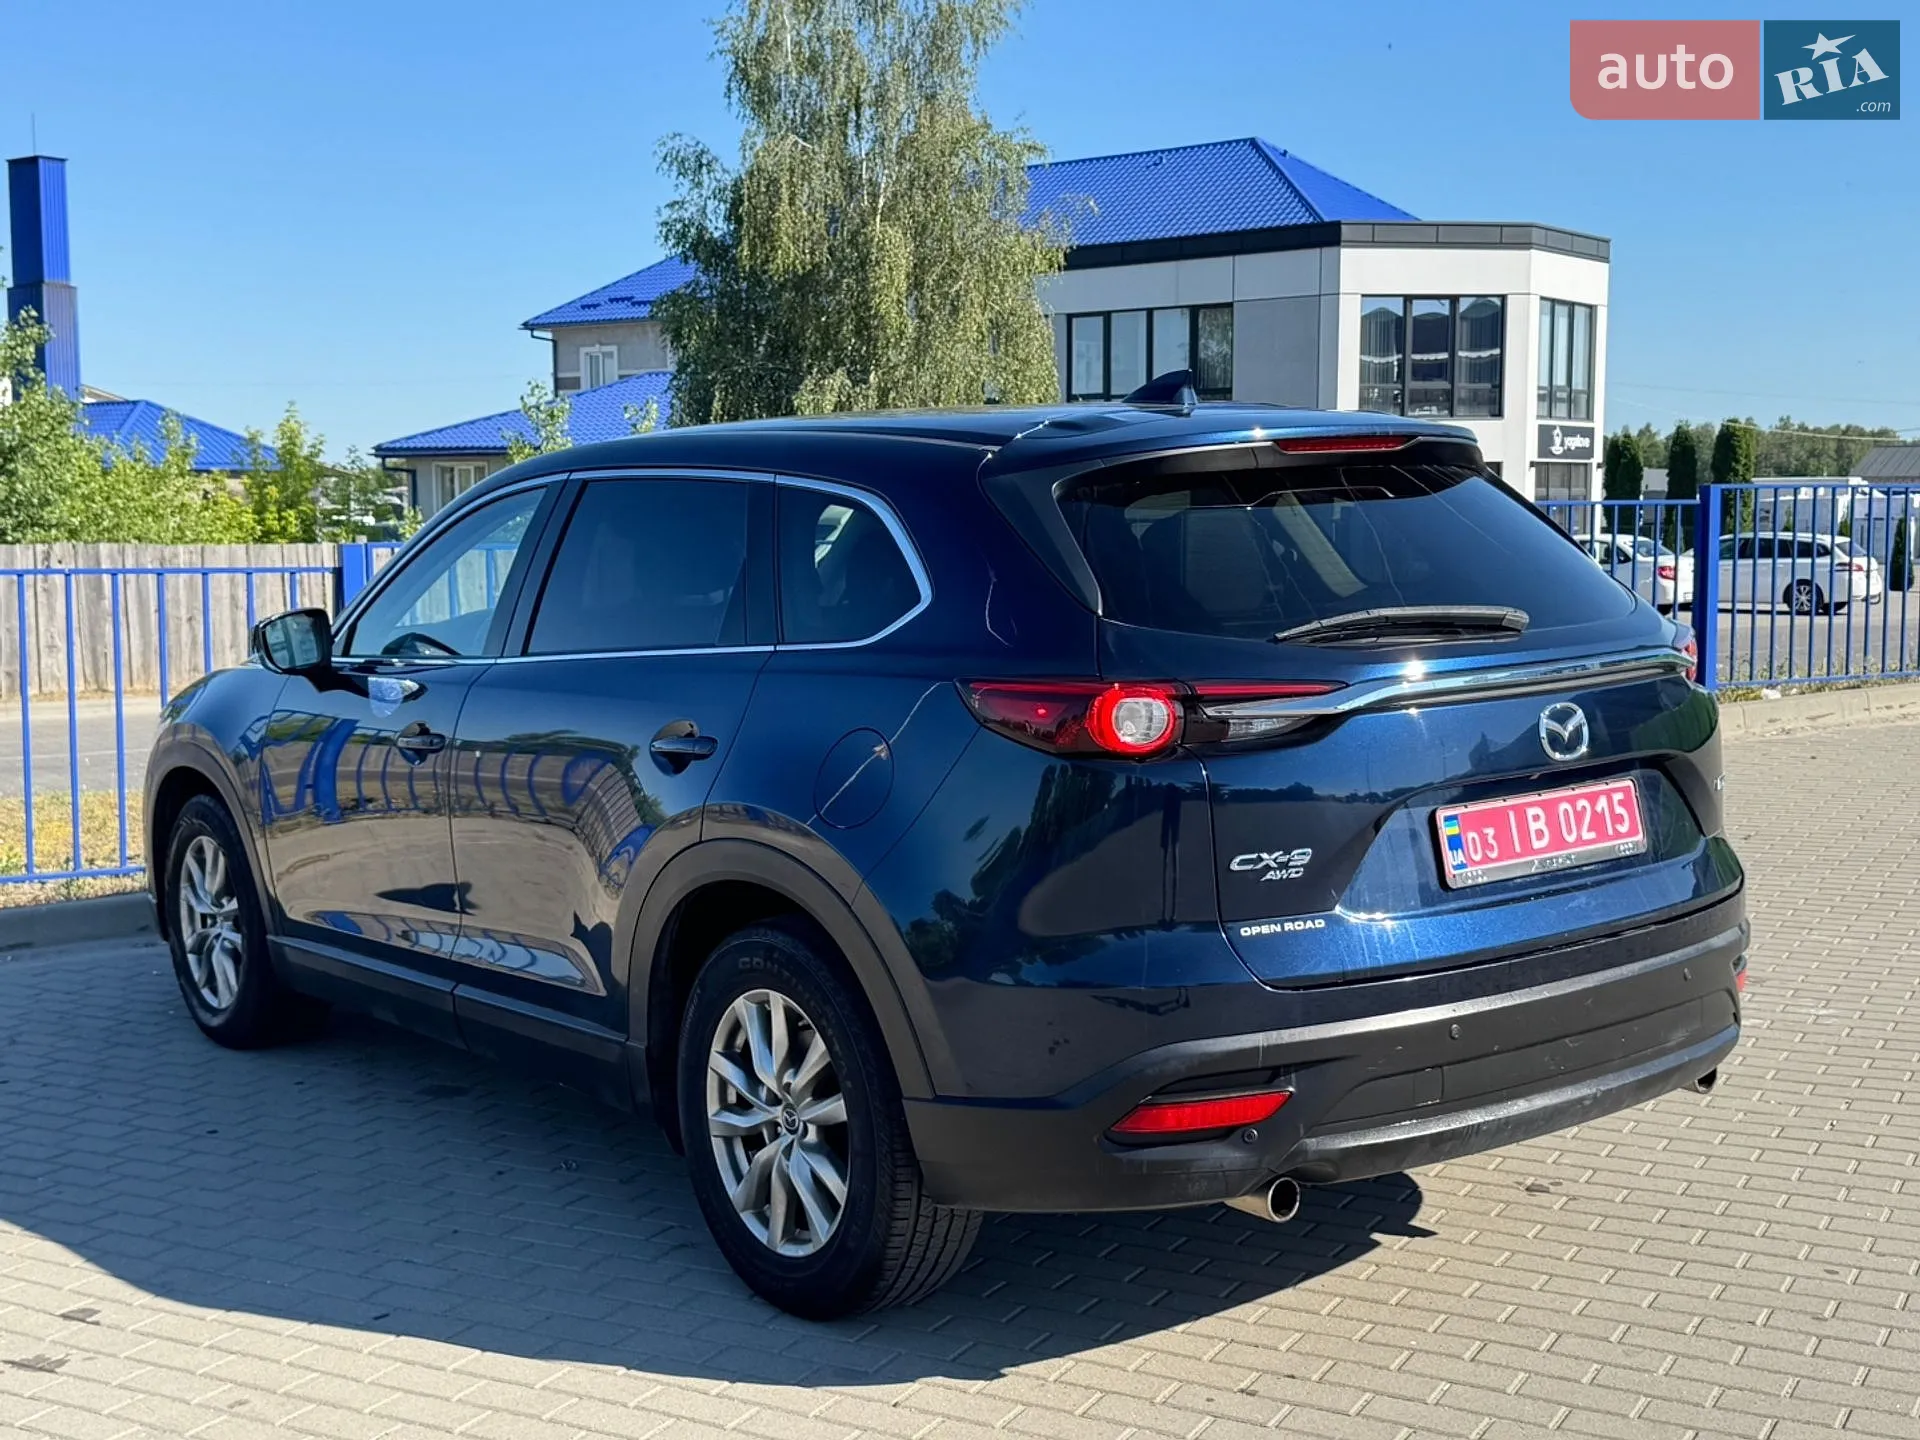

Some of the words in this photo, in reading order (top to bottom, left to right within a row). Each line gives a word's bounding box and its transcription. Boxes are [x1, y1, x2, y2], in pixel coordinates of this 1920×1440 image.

[1466, 827, 1499, 862] 03
[1558, 792, 1630, 844] 0215
[1230, 847, 1312, 871] CX-9
[1450, 849, 1466, 866] UA
[1260, 866, 1304, 881] AWD
[1240, 923, 1282, 937] OPEN
[1284, 918, 1326, 934] ROAD
